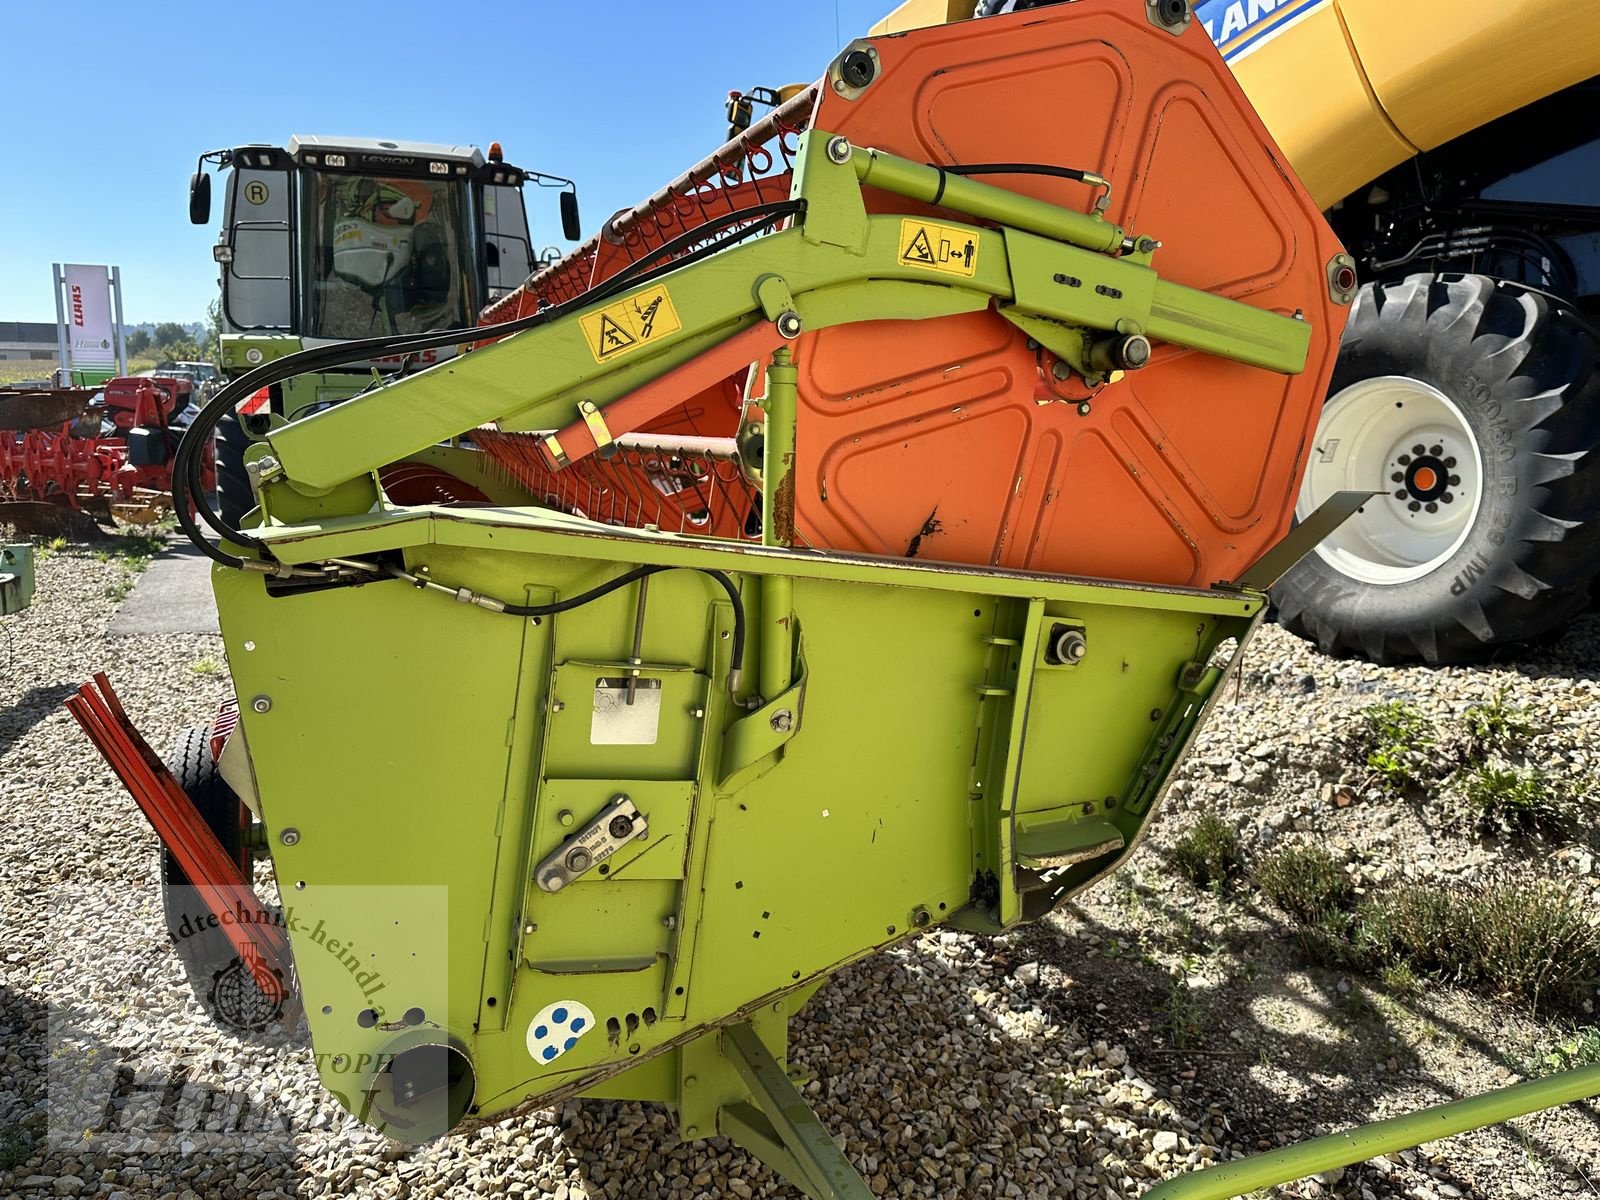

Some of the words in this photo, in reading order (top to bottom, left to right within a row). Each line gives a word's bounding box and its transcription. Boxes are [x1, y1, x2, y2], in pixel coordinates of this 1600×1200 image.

[361, 154, 415, 166] LEXION
[250, 185, 263, 201] R
[71, 285, 84, 327] CLAAS
[1450, 552, 1491, 597] IMP
